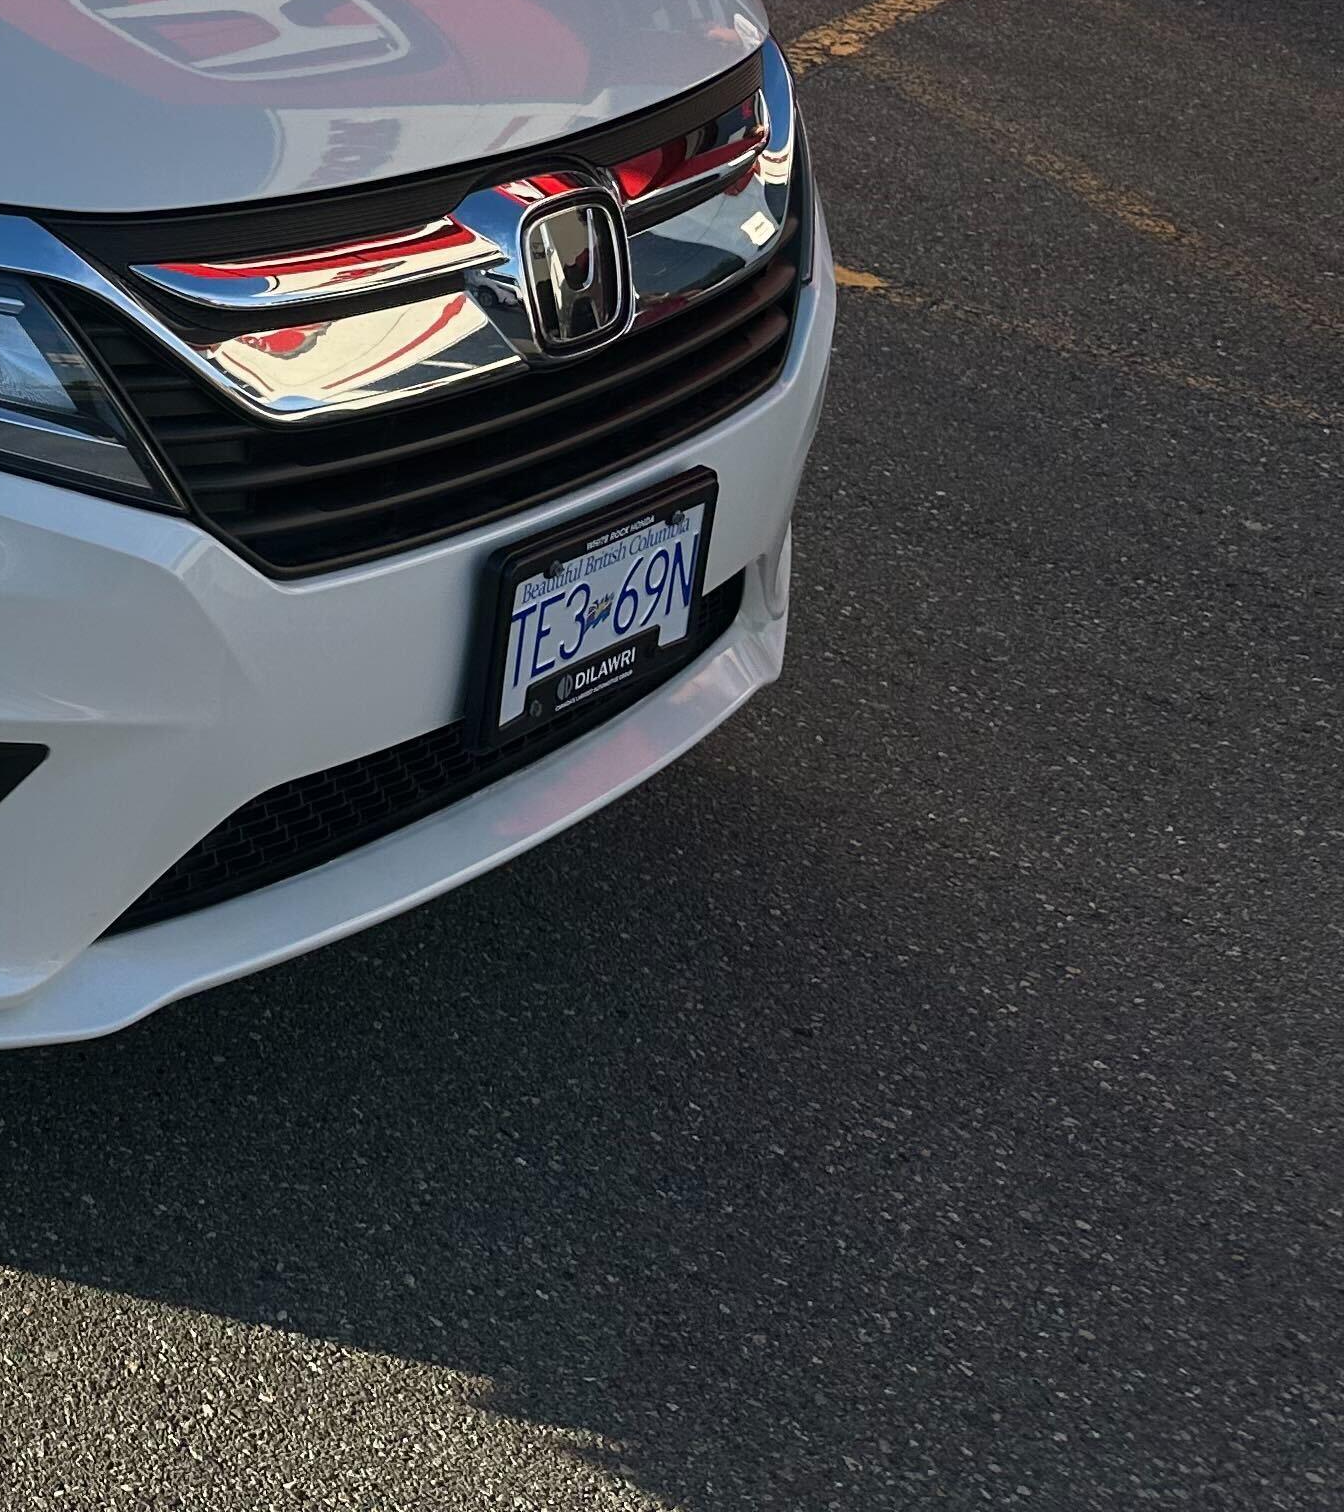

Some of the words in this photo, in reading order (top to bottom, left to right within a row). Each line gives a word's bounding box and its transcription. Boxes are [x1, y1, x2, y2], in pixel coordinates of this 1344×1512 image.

[521, 560, 582, 604] Beautiful
[583, 544, 627, 578] British
[628, 516, 690, 558] Columbia
[511, 583, 591, 688] TE3
[613, 532, 700, 635] 69N
[573, 646, 637, 690] DILAWRI
